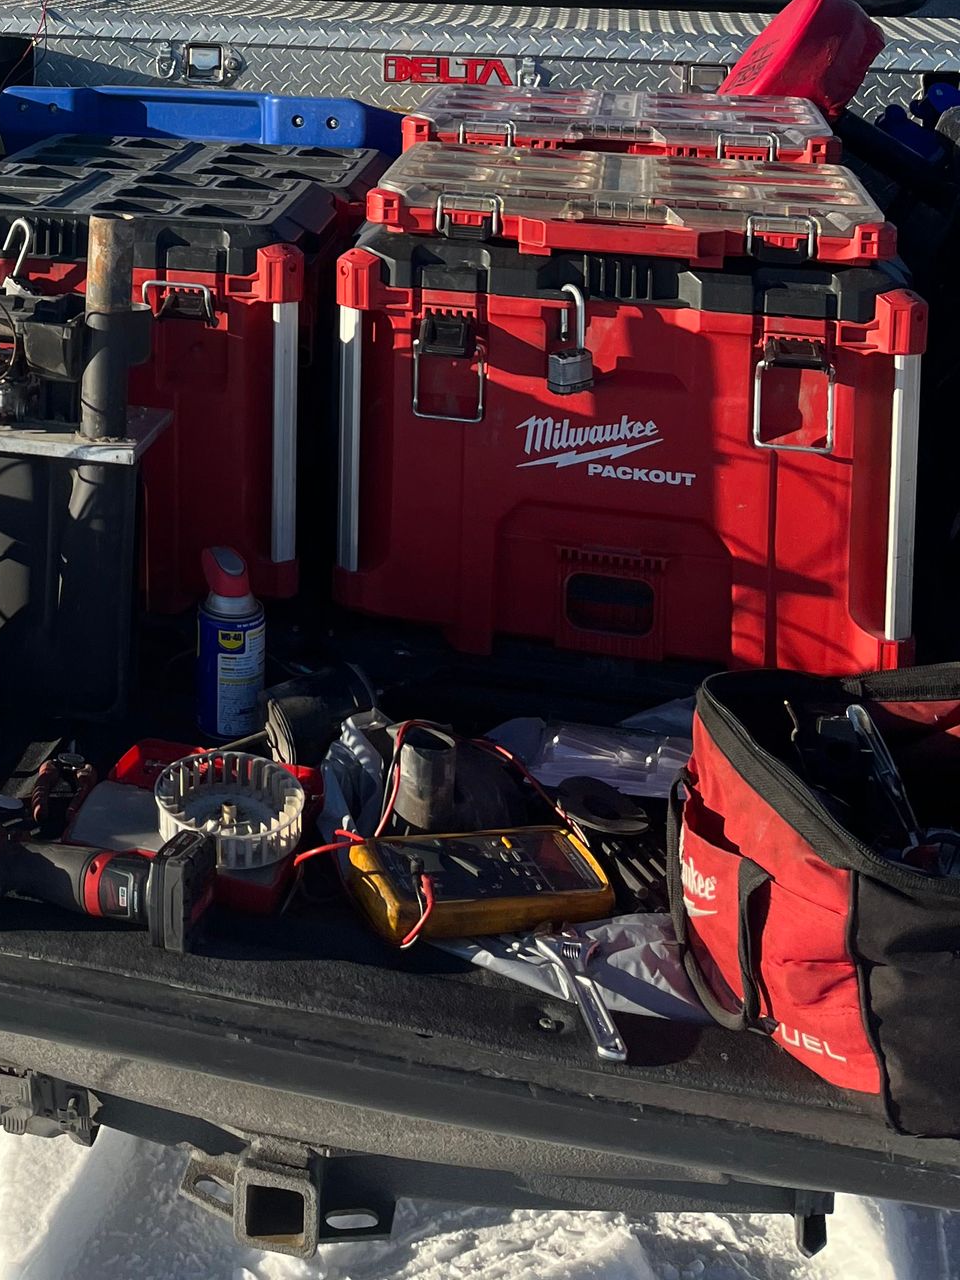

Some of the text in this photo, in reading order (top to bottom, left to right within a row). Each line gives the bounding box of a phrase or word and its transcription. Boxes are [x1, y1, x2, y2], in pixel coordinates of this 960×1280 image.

[384, 56, 513, 86] DELTA
[515, 415, 659, 455] Milwaukee
[587, 463, 697, 486] PACKOUT
[773, 1022, 848, 1062] UEL
